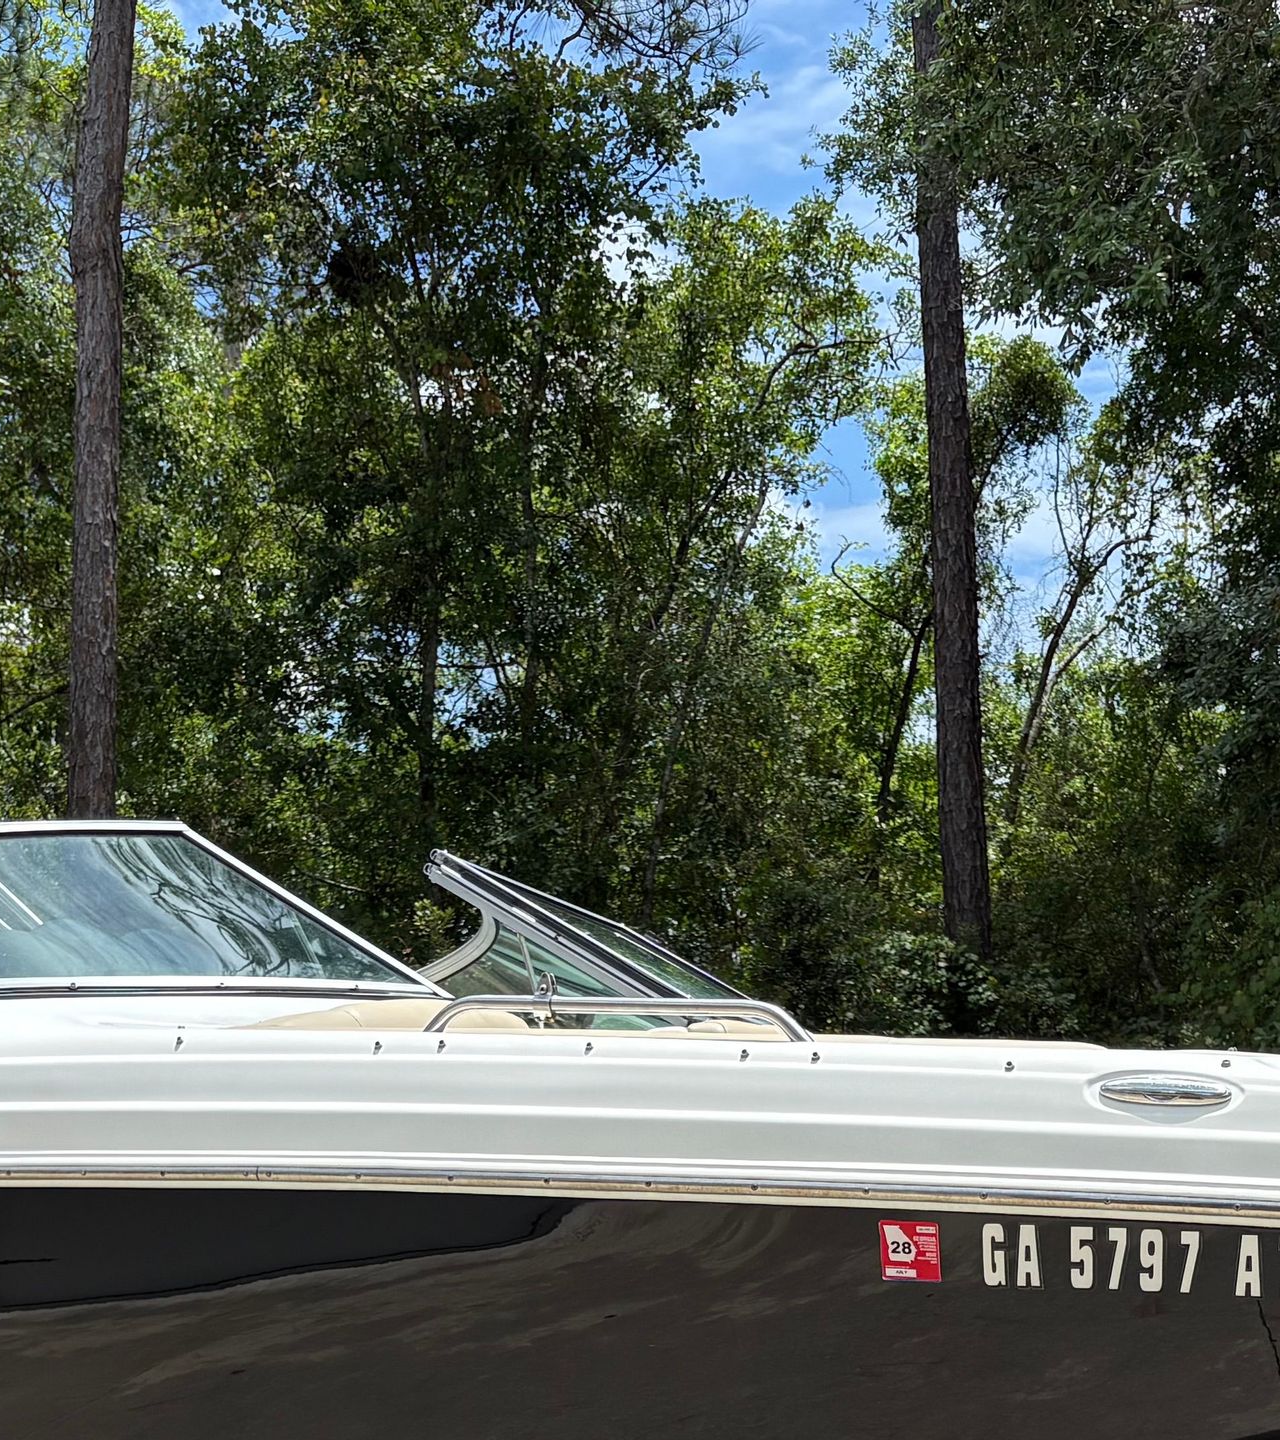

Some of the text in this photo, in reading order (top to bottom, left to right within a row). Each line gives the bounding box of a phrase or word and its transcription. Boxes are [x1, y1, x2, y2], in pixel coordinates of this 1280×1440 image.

[890, 1240, 912, 1255] 28
[981, 1222, 1042, 1288] GA
[1069, 1225, 1201, 1294] 5797
